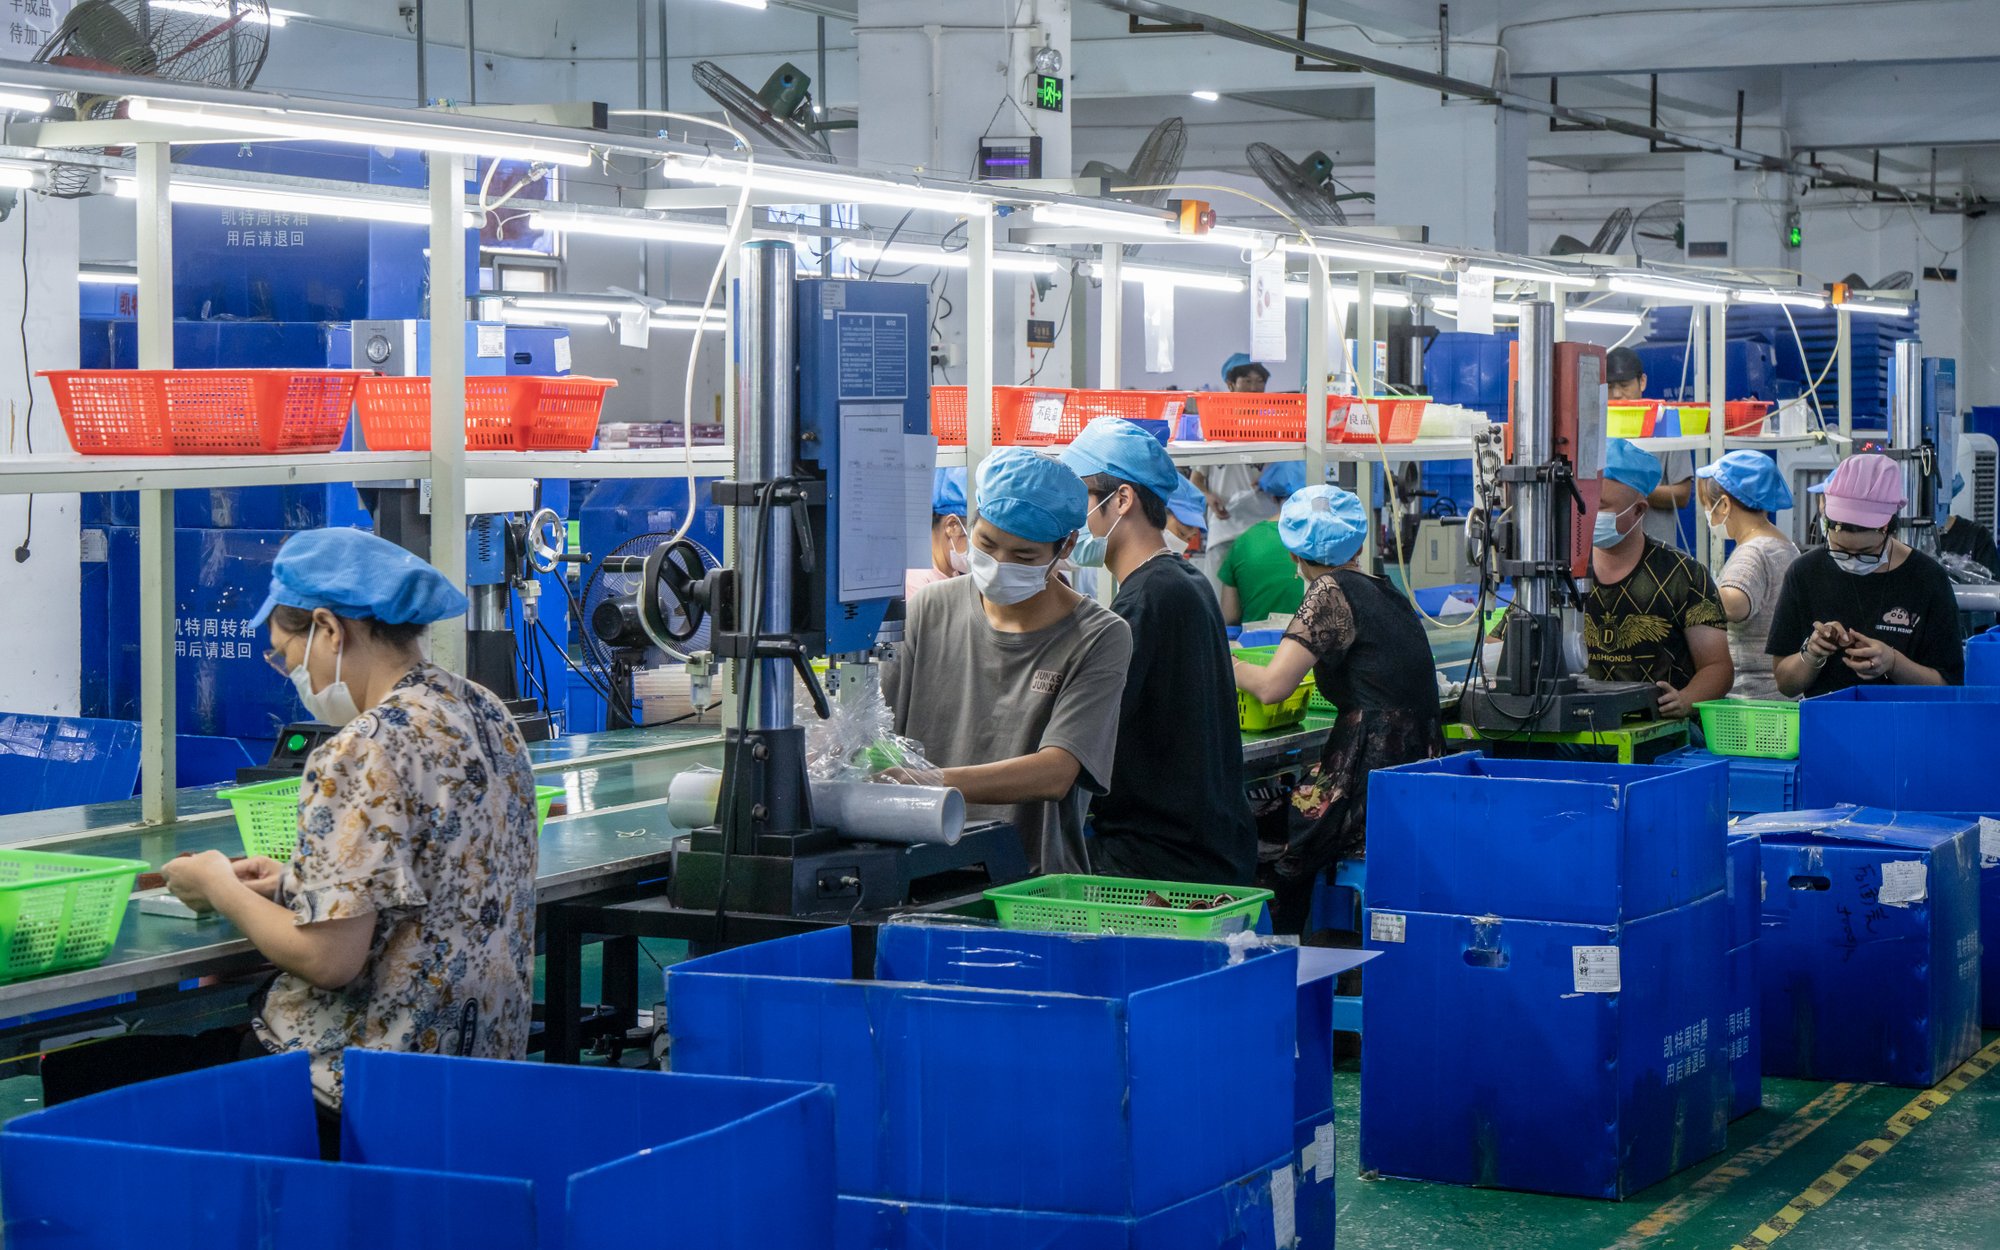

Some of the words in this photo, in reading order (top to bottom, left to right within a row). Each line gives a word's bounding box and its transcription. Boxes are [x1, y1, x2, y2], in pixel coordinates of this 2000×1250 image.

[10, 22, 51, 46] 待加工
[226, 230, 304, 247] 用后请退回
[1604, 629, 1614, 644] D
[175, 640, 252, 660] 用后请退回
[1034, 671, 1063, 684] JUNXS
[1663, 1017, 1708, 1059] 凯特周转箱
[1665, 1048, 1706, 1087] 用后请退回
